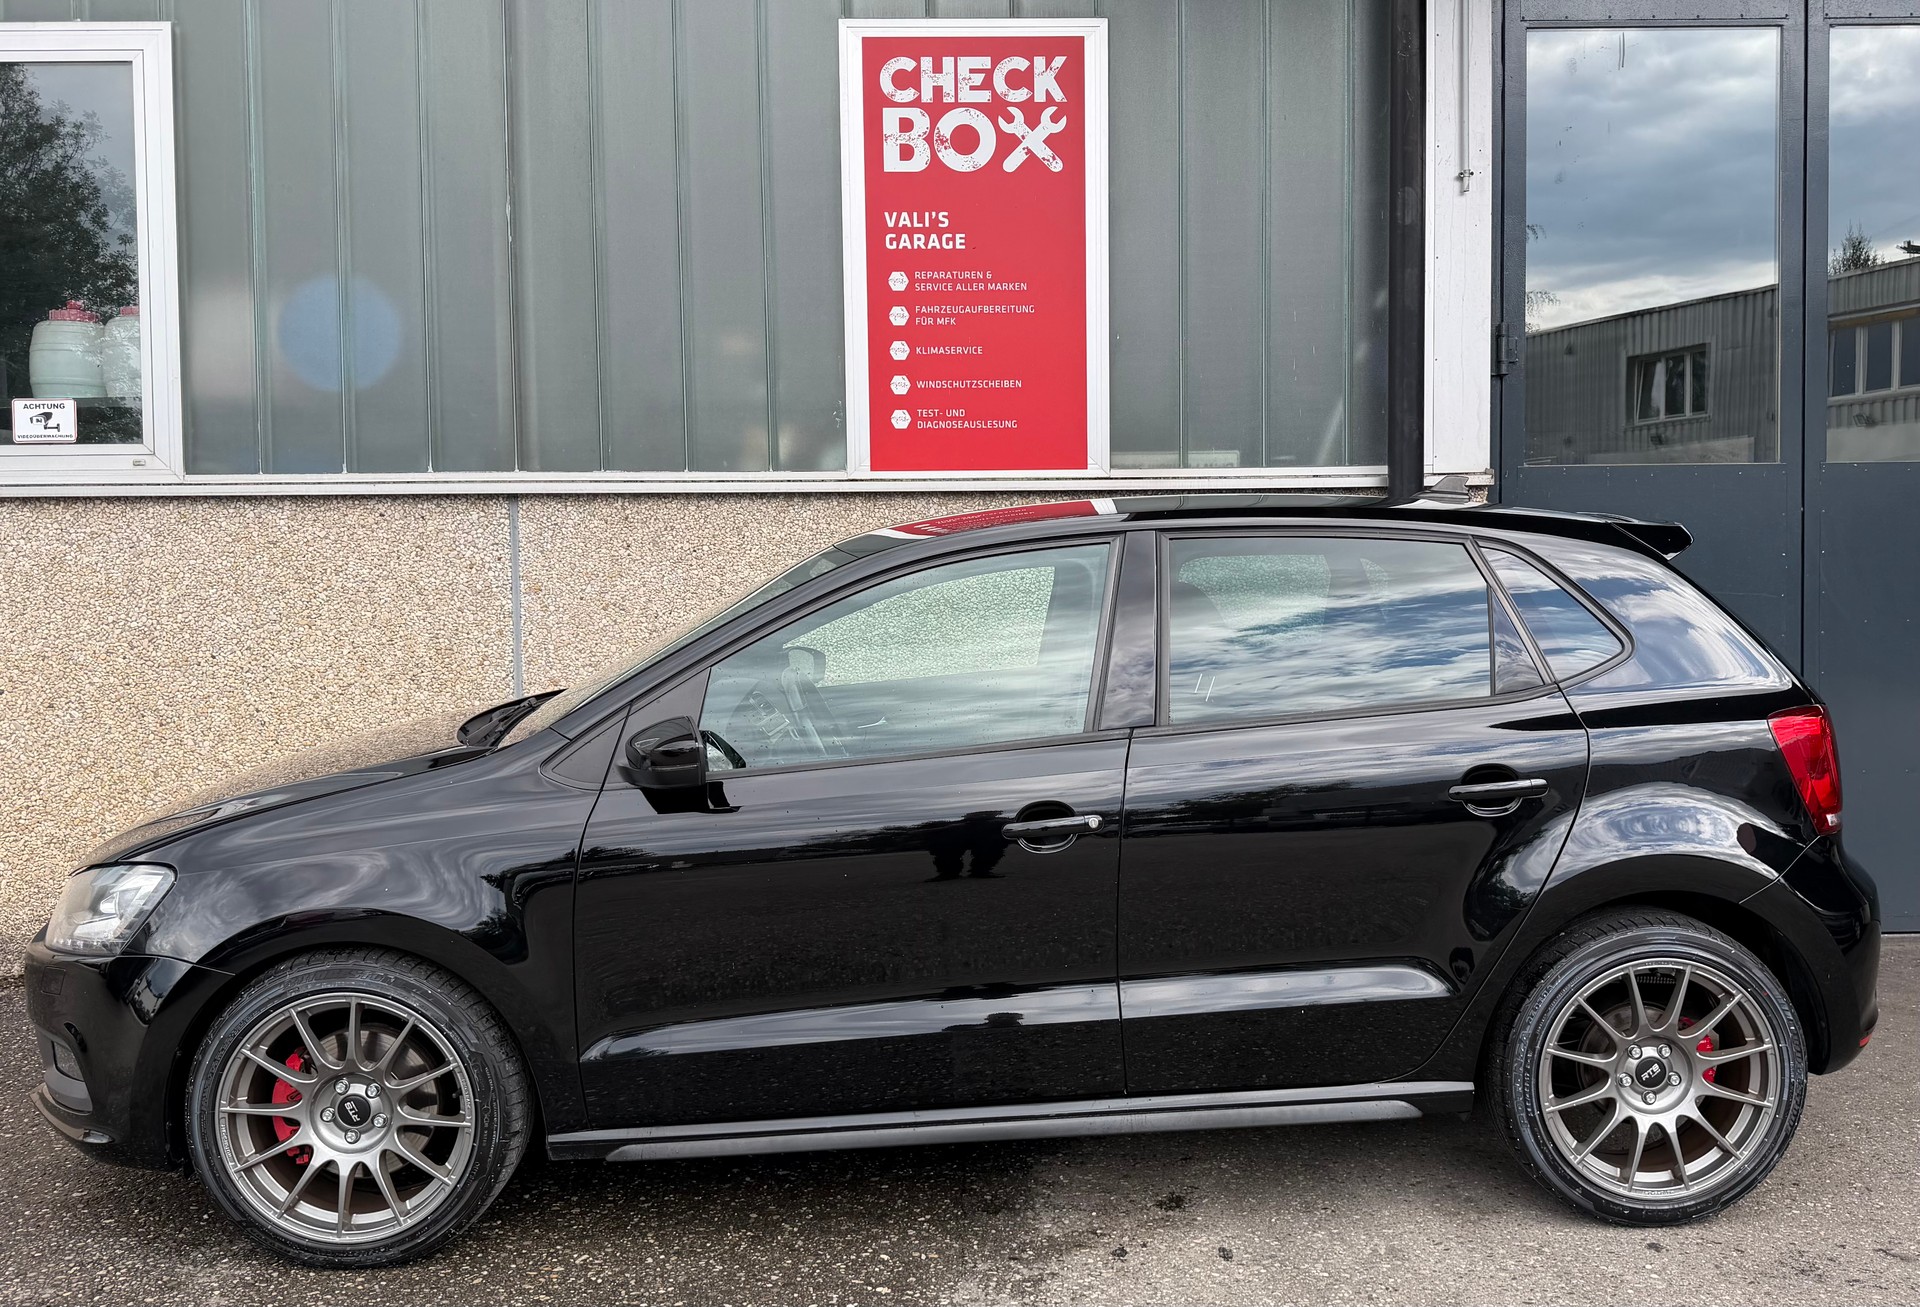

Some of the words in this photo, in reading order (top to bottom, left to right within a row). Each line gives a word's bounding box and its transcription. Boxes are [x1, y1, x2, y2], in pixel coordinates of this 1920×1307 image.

[879, 56, 1067, 103] CHECK
[884, 211, 949, 228] VALI'S
[885, 233, 966, 250] GARAGE
[914, 271, 983, 280] REPARATUREN
[986, 271, 993, 280] &
[914, 283, 953, 291] SERVICE
[955, 283, 985, 291] ALLER
[987, 282, 1027, 291] MARKEN
[915, 304, 1035, 314] FAHRZEUGAUFBEREITUNG
[915, 316, 934, 326] FÜR
[936, 317, 957, 326] MFK
[915, 346, 983, 355] KLIMASERVICE
[916, 380, 1022, 389] WINDSCHUTZSCHEIBEN
[916, 409, 943, 418] TEST-
[945, 409, 965, 417] UND
[917, 420, 1018, 429] DIAGNOSEAUSLESUNG
